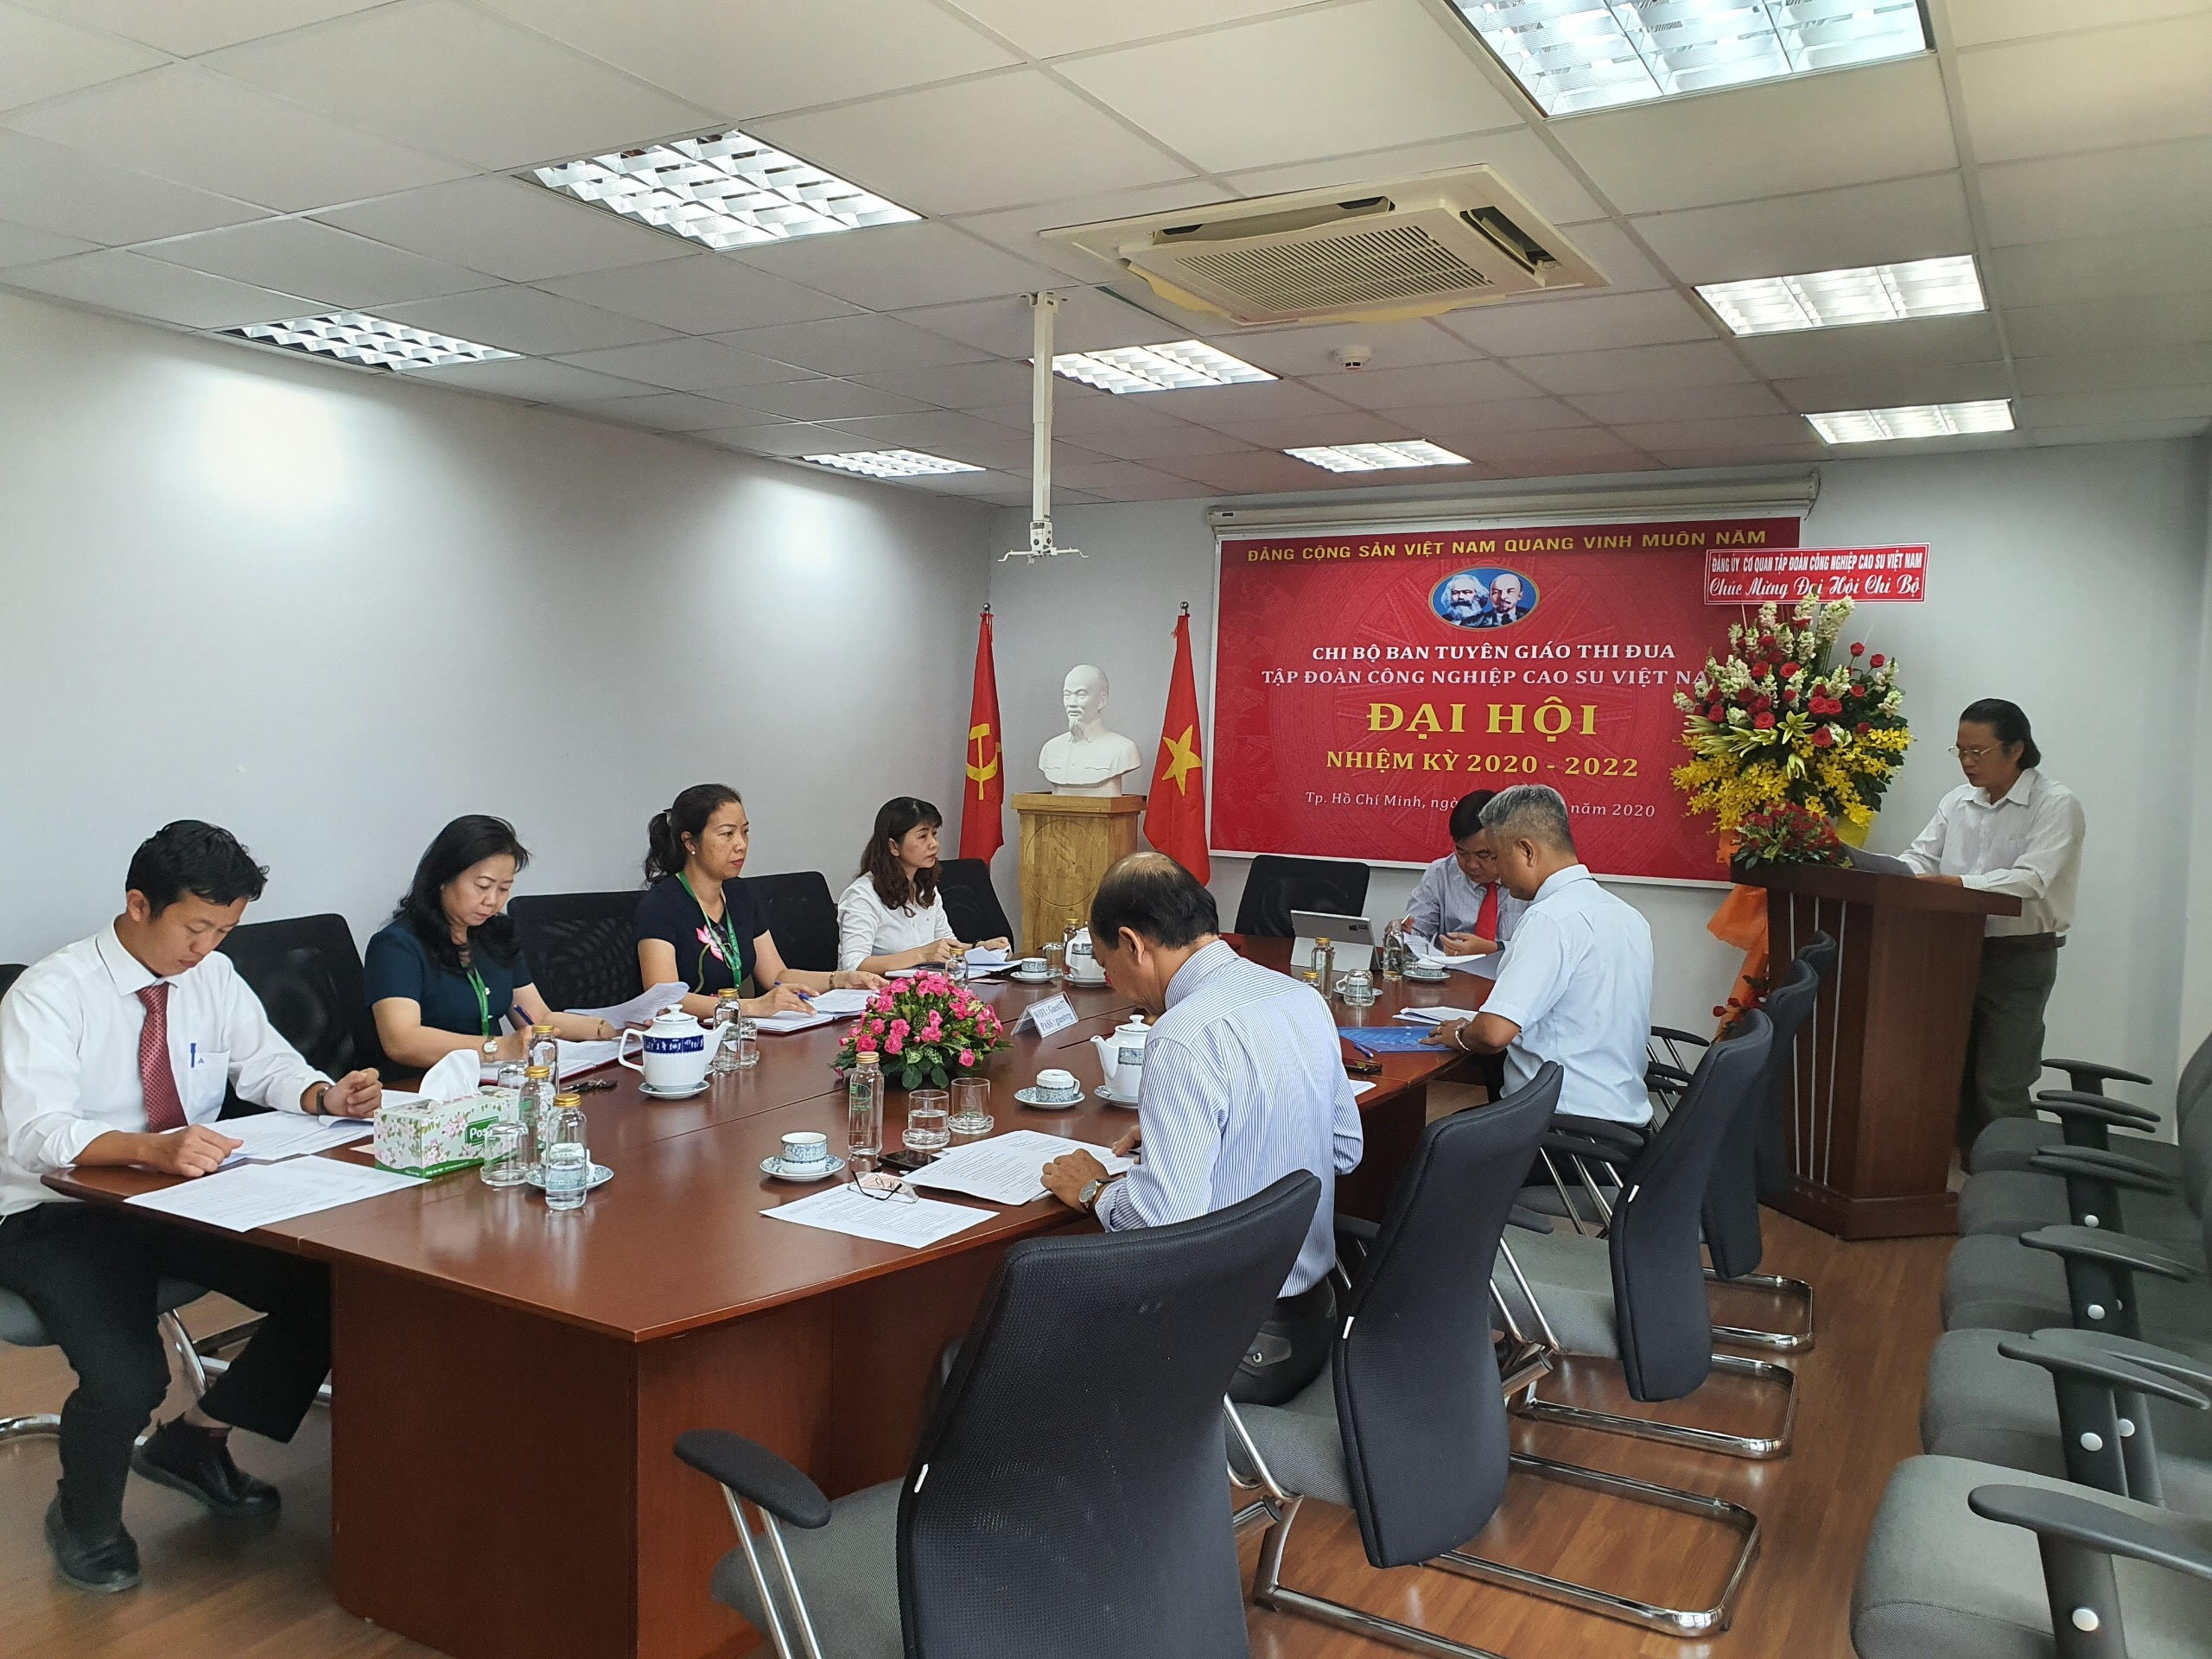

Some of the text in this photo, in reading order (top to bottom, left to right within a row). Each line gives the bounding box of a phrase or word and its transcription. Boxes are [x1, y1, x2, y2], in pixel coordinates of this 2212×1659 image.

[1248, 529, 1766, 562] ĐẢNG CỘNG SẢN VIỆT NAM QUANG VINH MUÔN NĂM
[1712, 550, 1923, 575] ĐẢNG ỦY CƠ QUAN TẬP ĐOÀN CÔNG NGHIỆP CAO SU VIỆT NAM
[1709, 577, 1742, 596] Chúc
[1745, 576, 1789, 600] Mừng
[1865, 574, 1891, 594] Chi
[1897, 574, 1921, 597] Bộ
[1313, 640, 1675, 663] CHI BỘ BAN TUYÊN GIÁO THI ĐUA
[1262, 667, 1707, 687] TẬP ĐOÀN CÔNG NGHIỆP CAO SU VIỆT NA
[1366, 696, 1599, 742] ĐẠI HỘI
[1326, 747, 1414, 773] NHIỆM
[1422, 749, 1460, 772] KỲ
[1467, 753, 1538, 773] 2020
[1564, 757, 1638, 777] 2022
[1306, 791, 1656, 817] Tp. Hồ Chí Minh, ngà năm 2020
